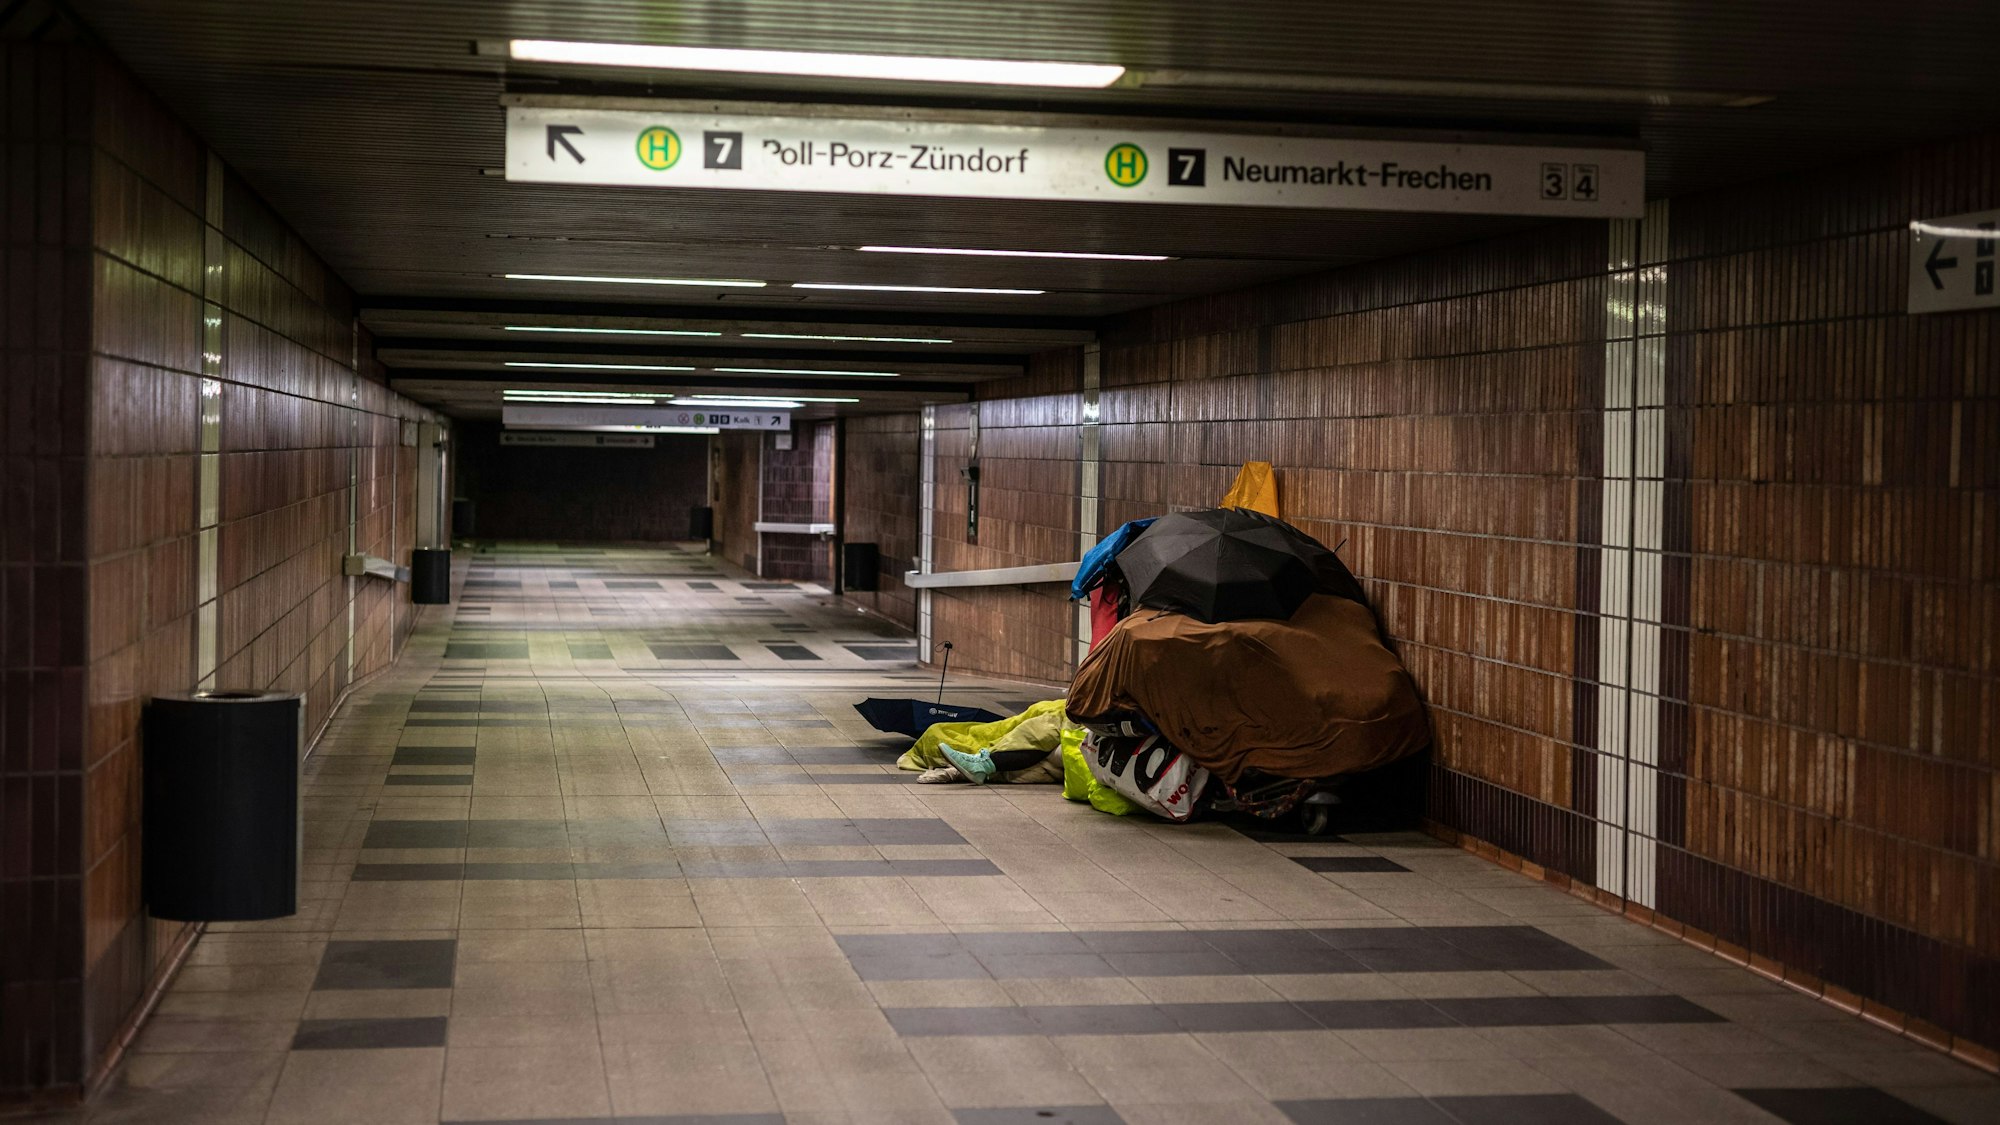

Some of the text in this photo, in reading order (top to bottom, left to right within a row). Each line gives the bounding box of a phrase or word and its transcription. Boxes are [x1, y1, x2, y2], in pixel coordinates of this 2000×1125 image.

[712, 137, 732, 165] 7
[1177, 154, 1196, 181] 7
[1223, 156, 1493, 192] Neumarkt-Frechen
[1545, 173, 1562, 197] 3
[1576, 175, 1595, 198] 4
